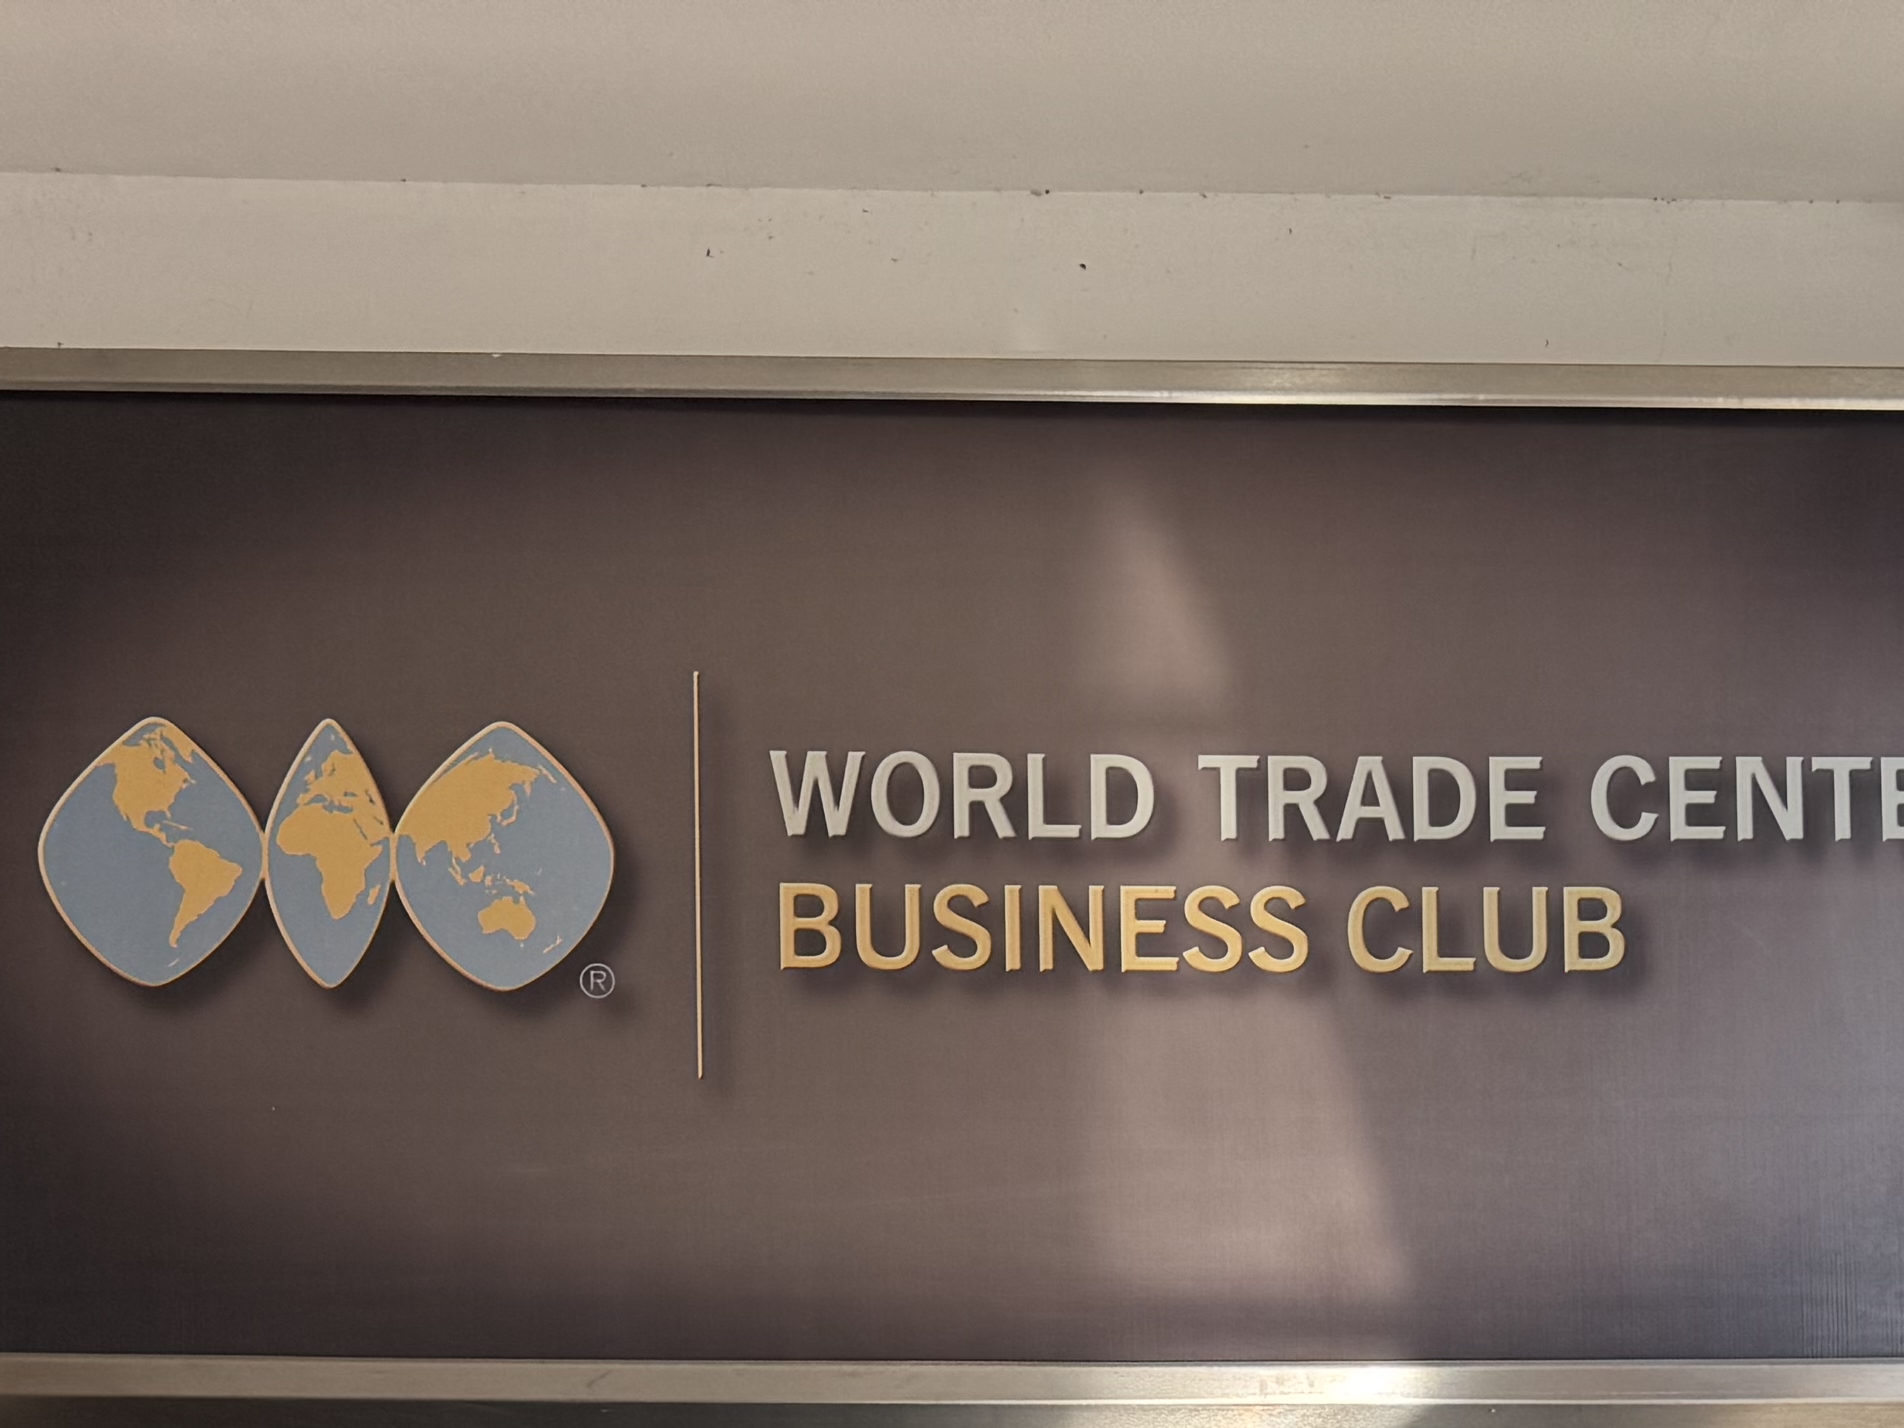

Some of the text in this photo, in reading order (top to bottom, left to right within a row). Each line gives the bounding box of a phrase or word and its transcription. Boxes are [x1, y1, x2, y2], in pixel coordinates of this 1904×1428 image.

[769, 750, 1154, 841] WORLD
[1198, 754, 1546, 842] TRADE
[779, 882, 1626, 974] BUSINESS CLUB
